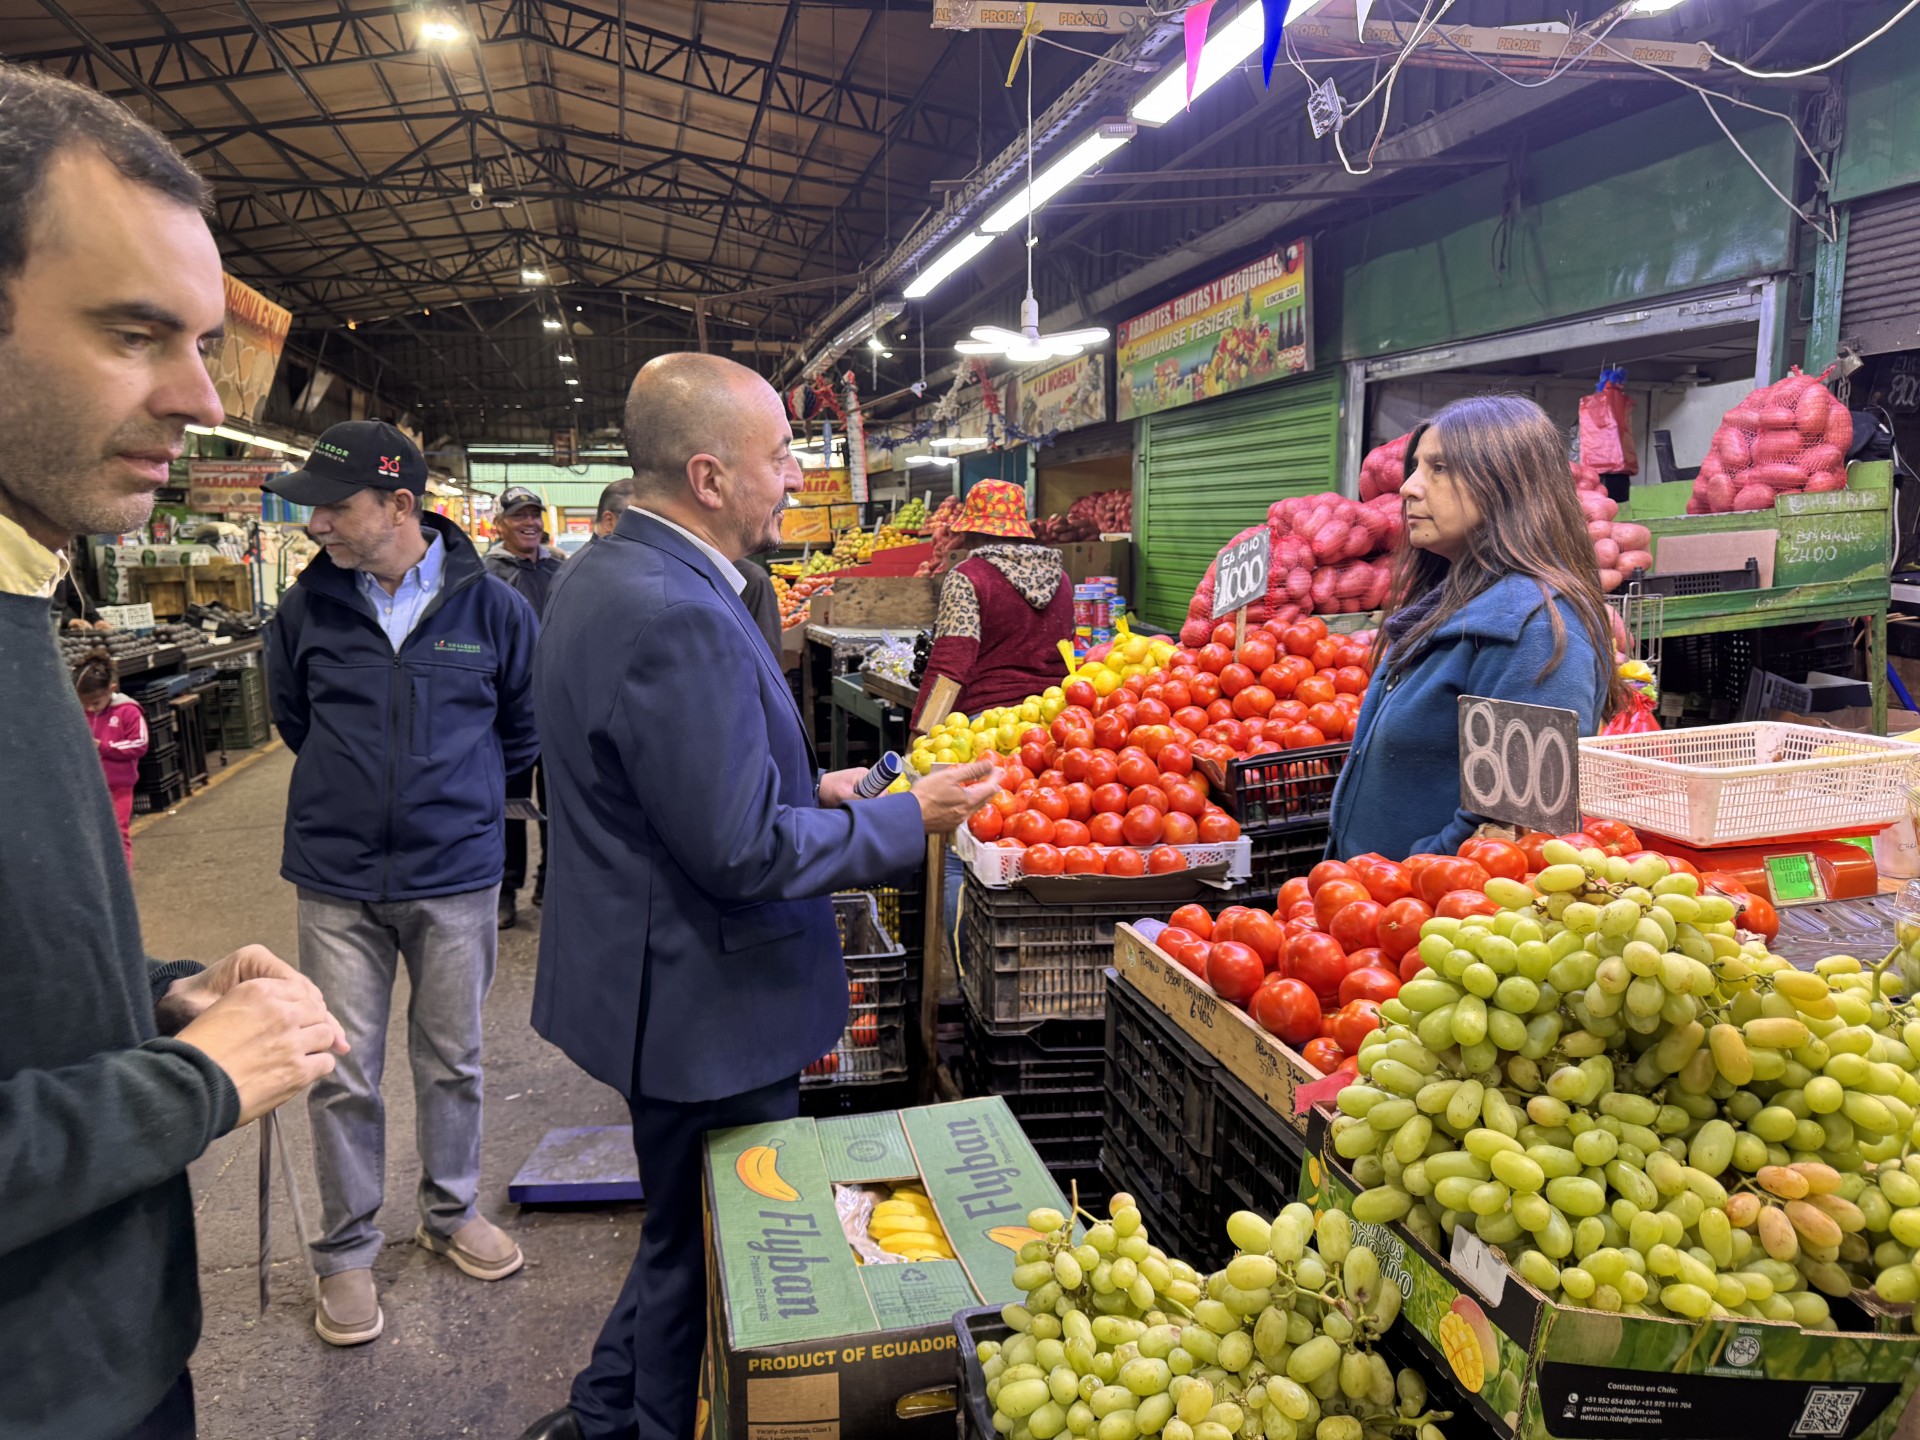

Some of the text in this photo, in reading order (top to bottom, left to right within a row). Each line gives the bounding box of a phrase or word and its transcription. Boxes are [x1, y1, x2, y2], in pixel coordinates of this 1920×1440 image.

[1497, 36, 1542, 52] PROPAL
[1632, 46, 1676, 62] PROPAL
[1174, 286, 1211, 322] FRUTAS
[1211, 283, 1221, 305] Y
[1220, 252, 1283, 301] VERDURAS
[1266, 284, 1299, 306] LOCAL 201
[1463, 701, 1571, 816] 800
[944, 1116, 1023, 1221] Flyban
[746, 1210, 831, 1320] Flyban
[755, 1288, 769, 1322] Bananas
[748, 1334, 957, 1373] PRODUCT OF ECUADOR
[1598, 1396, 1610, 1405] 952
[1623, 1399, 1636, 1407] 000
[1607, 1381, 1645, 1393] Contactos
[1657, 1385, 1679, 1395] Chile:
[1581, 1404, 1661, 1416] gerencia@nelatam.com
